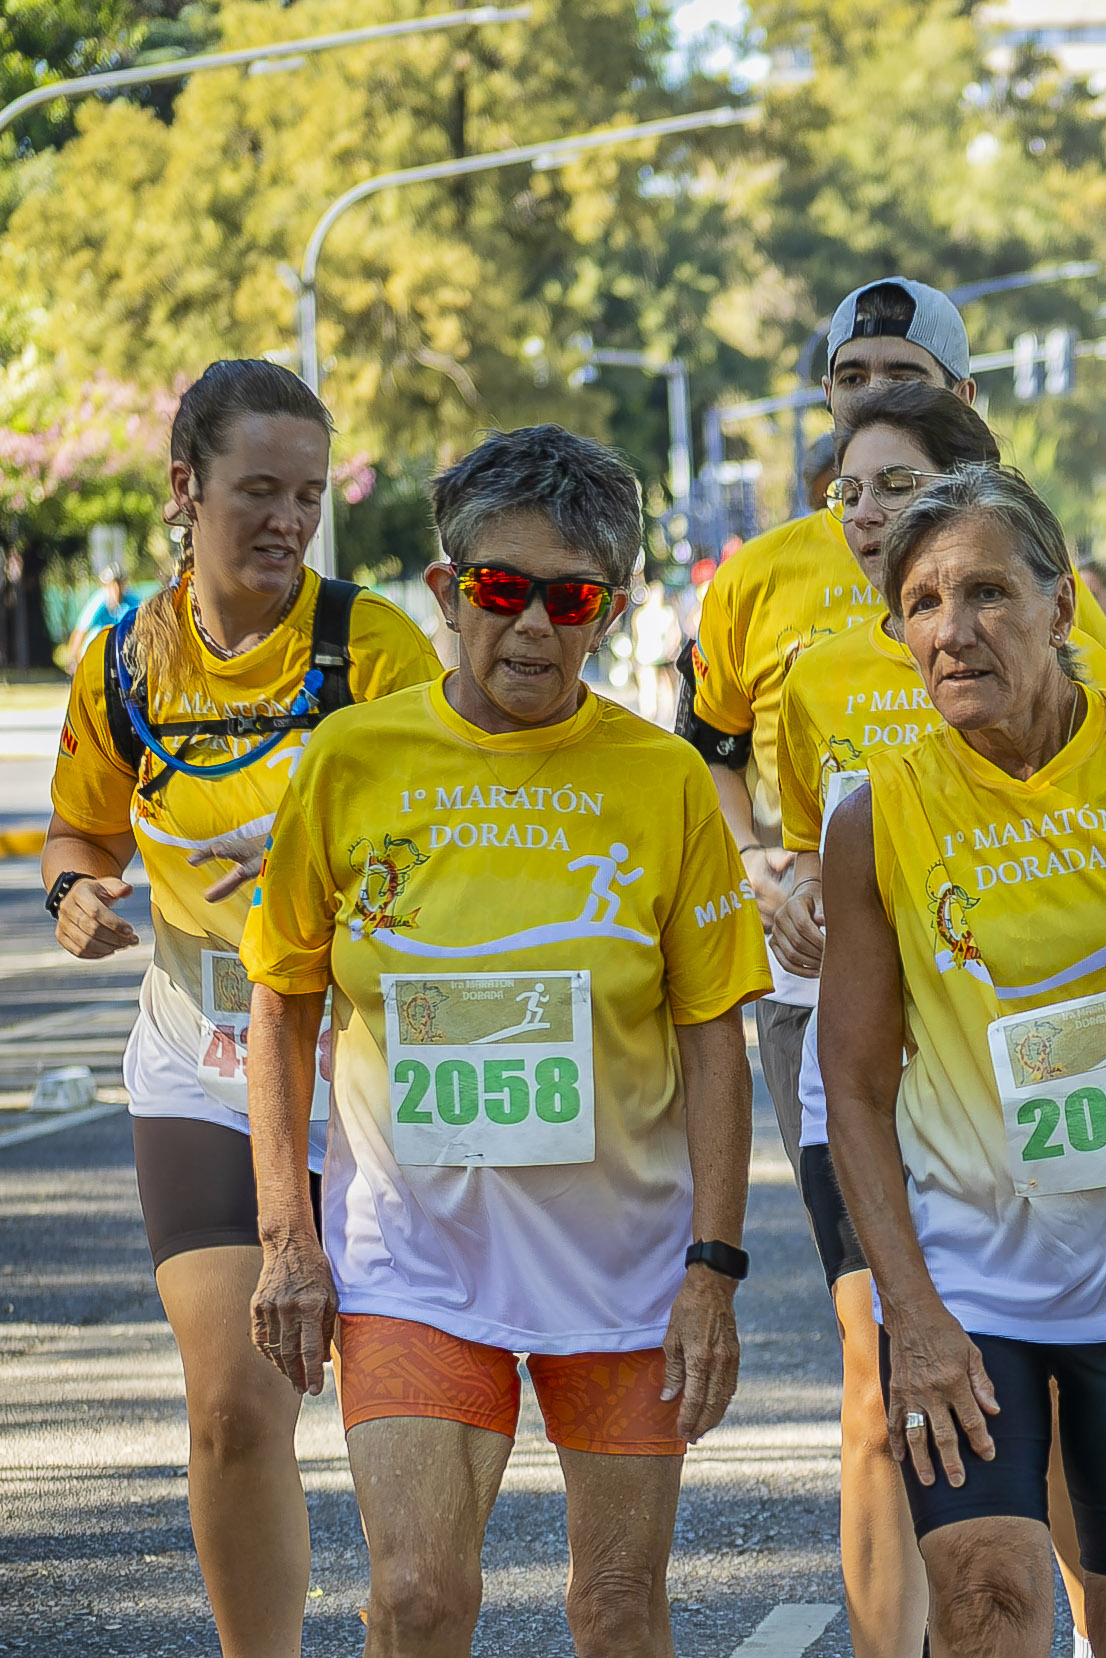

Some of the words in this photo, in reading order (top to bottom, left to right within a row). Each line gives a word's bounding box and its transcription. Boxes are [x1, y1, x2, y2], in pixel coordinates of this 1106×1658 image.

[870, 687, 933, 712] MAR
[434, 783, 605, 816] MARATÓN
[429, 823, 571, 852] DORADA
[394, 1056, 581, 1126] 2058
